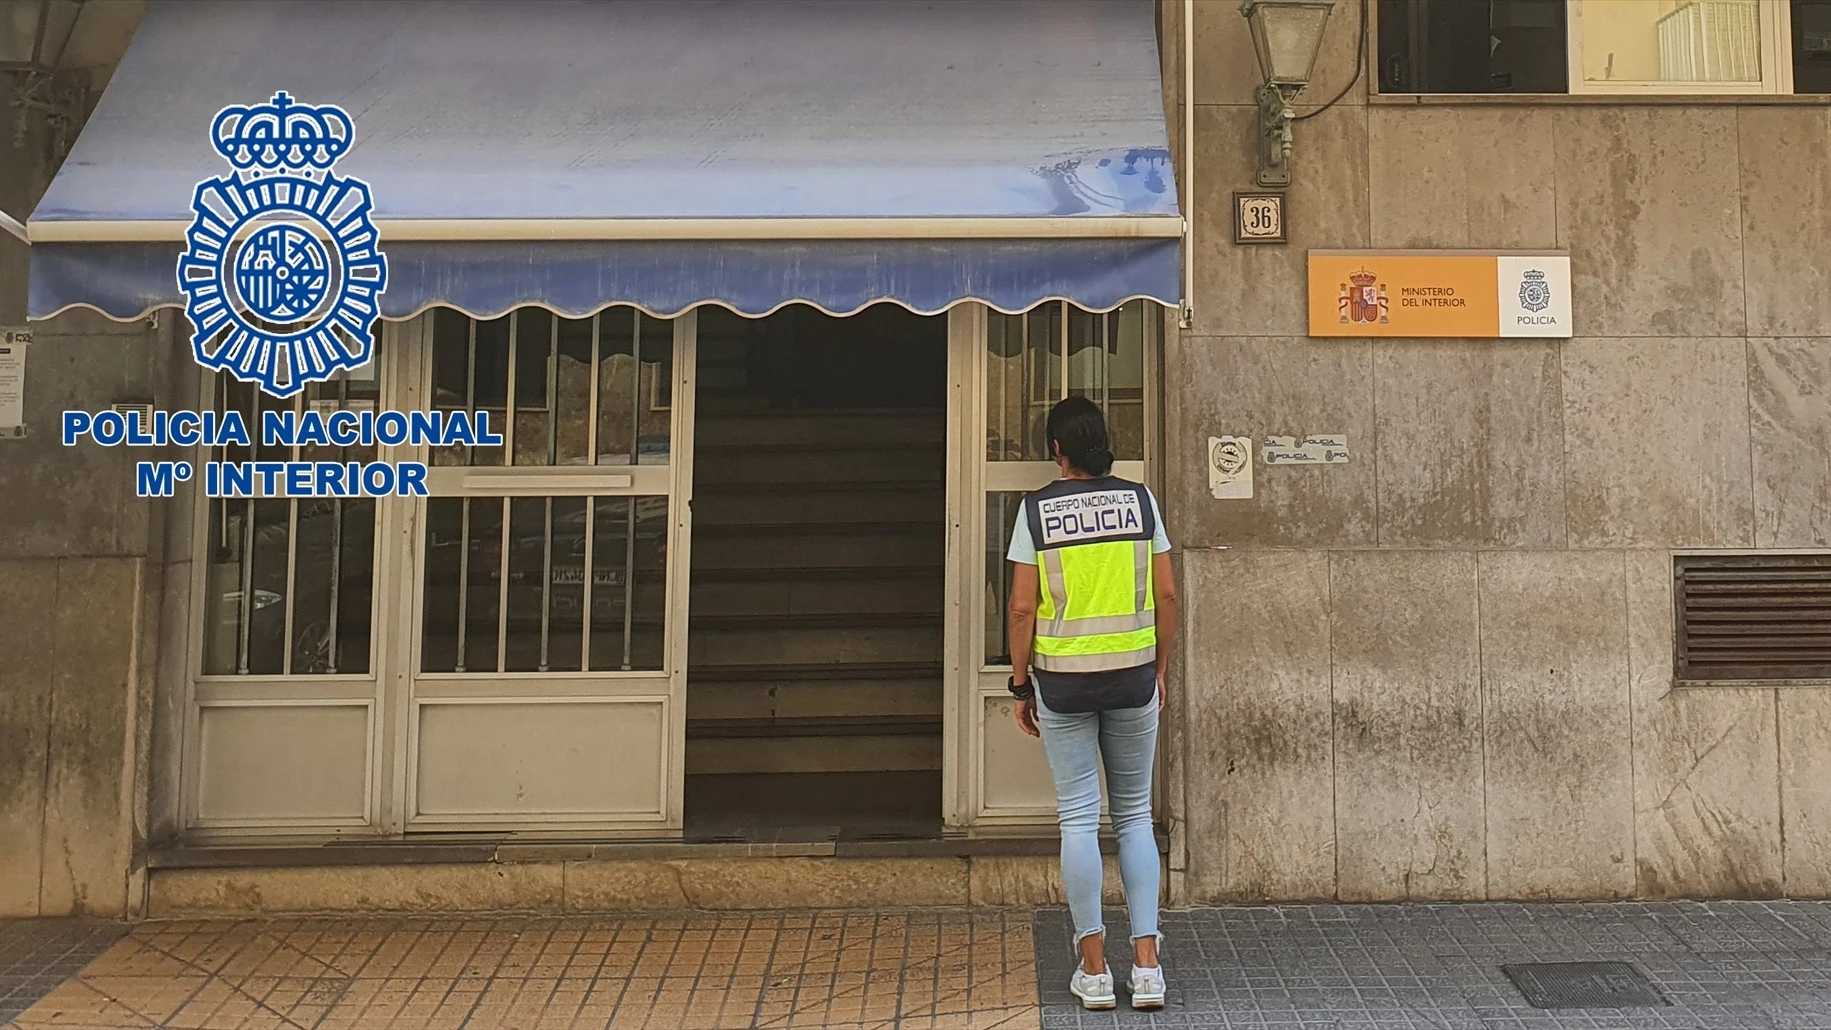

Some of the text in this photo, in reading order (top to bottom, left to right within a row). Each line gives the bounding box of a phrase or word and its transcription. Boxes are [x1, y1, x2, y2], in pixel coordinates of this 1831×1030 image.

[1250, 206, 1271, 228] 36
[1401, 287, 1455, 296] MINISTERIO
[1402, 298, 1466, 307] DEL INTERIOR
[1516, 316, 1557, 325] POLICIA
[1042, 493, 1136, 514] CUERPO NACIONAL DE
[1044, 507, 1139, 538] POLICIA
